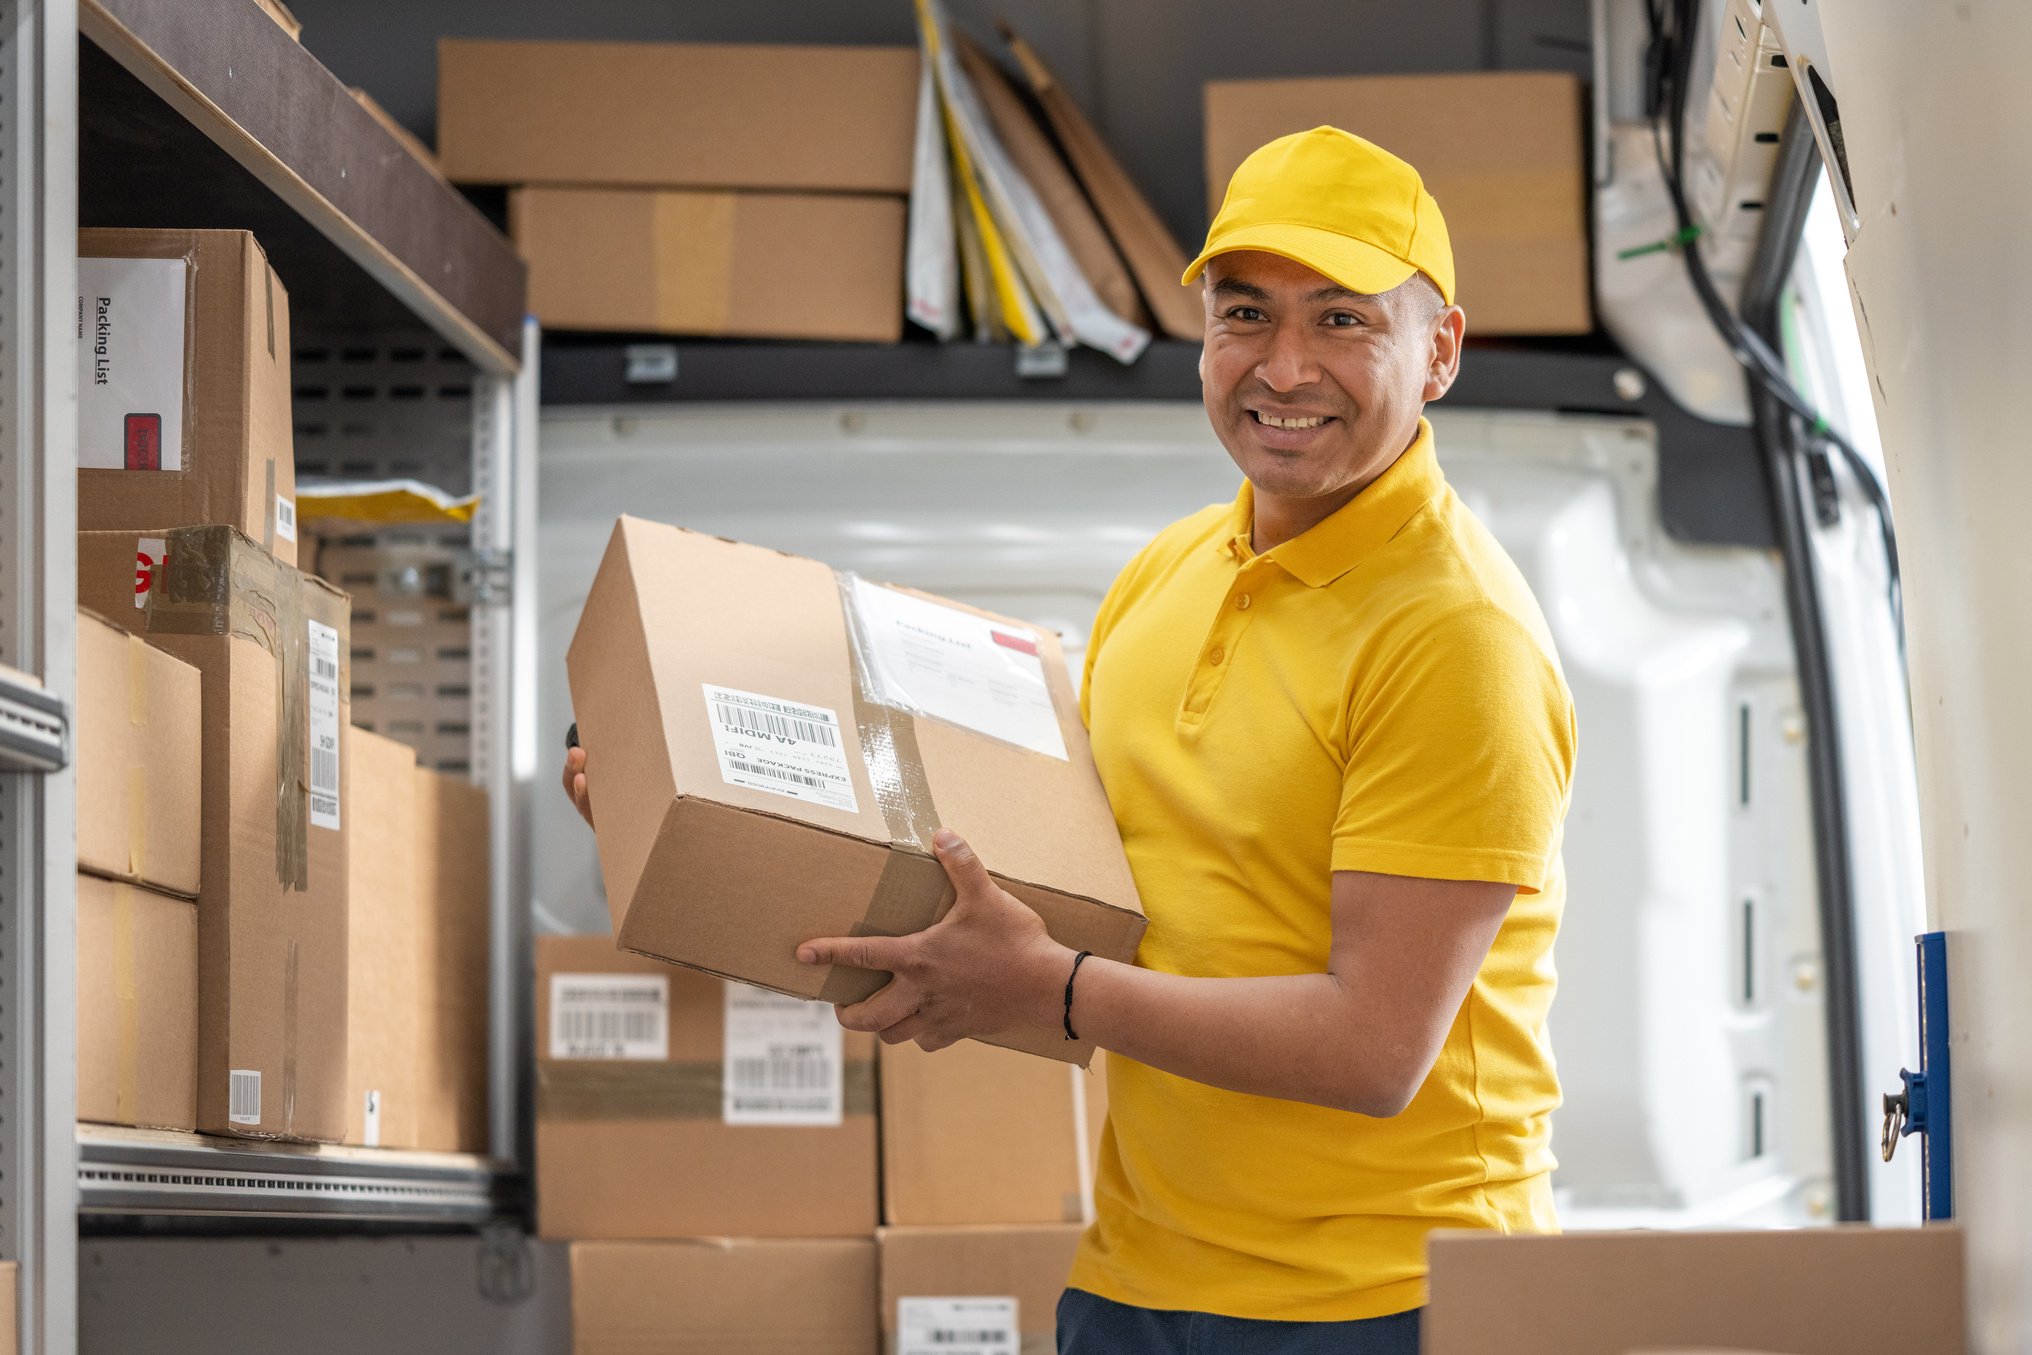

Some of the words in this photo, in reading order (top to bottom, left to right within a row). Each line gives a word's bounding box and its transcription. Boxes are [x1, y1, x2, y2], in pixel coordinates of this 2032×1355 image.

[95, 297, 111, 355] Packing
[96, 359, 110, 385] List
[775, 735, 797, 746] 4A
[757, 758, 803, 773] PACKAGE
[804, 768, 847, 783] EXPRESS
